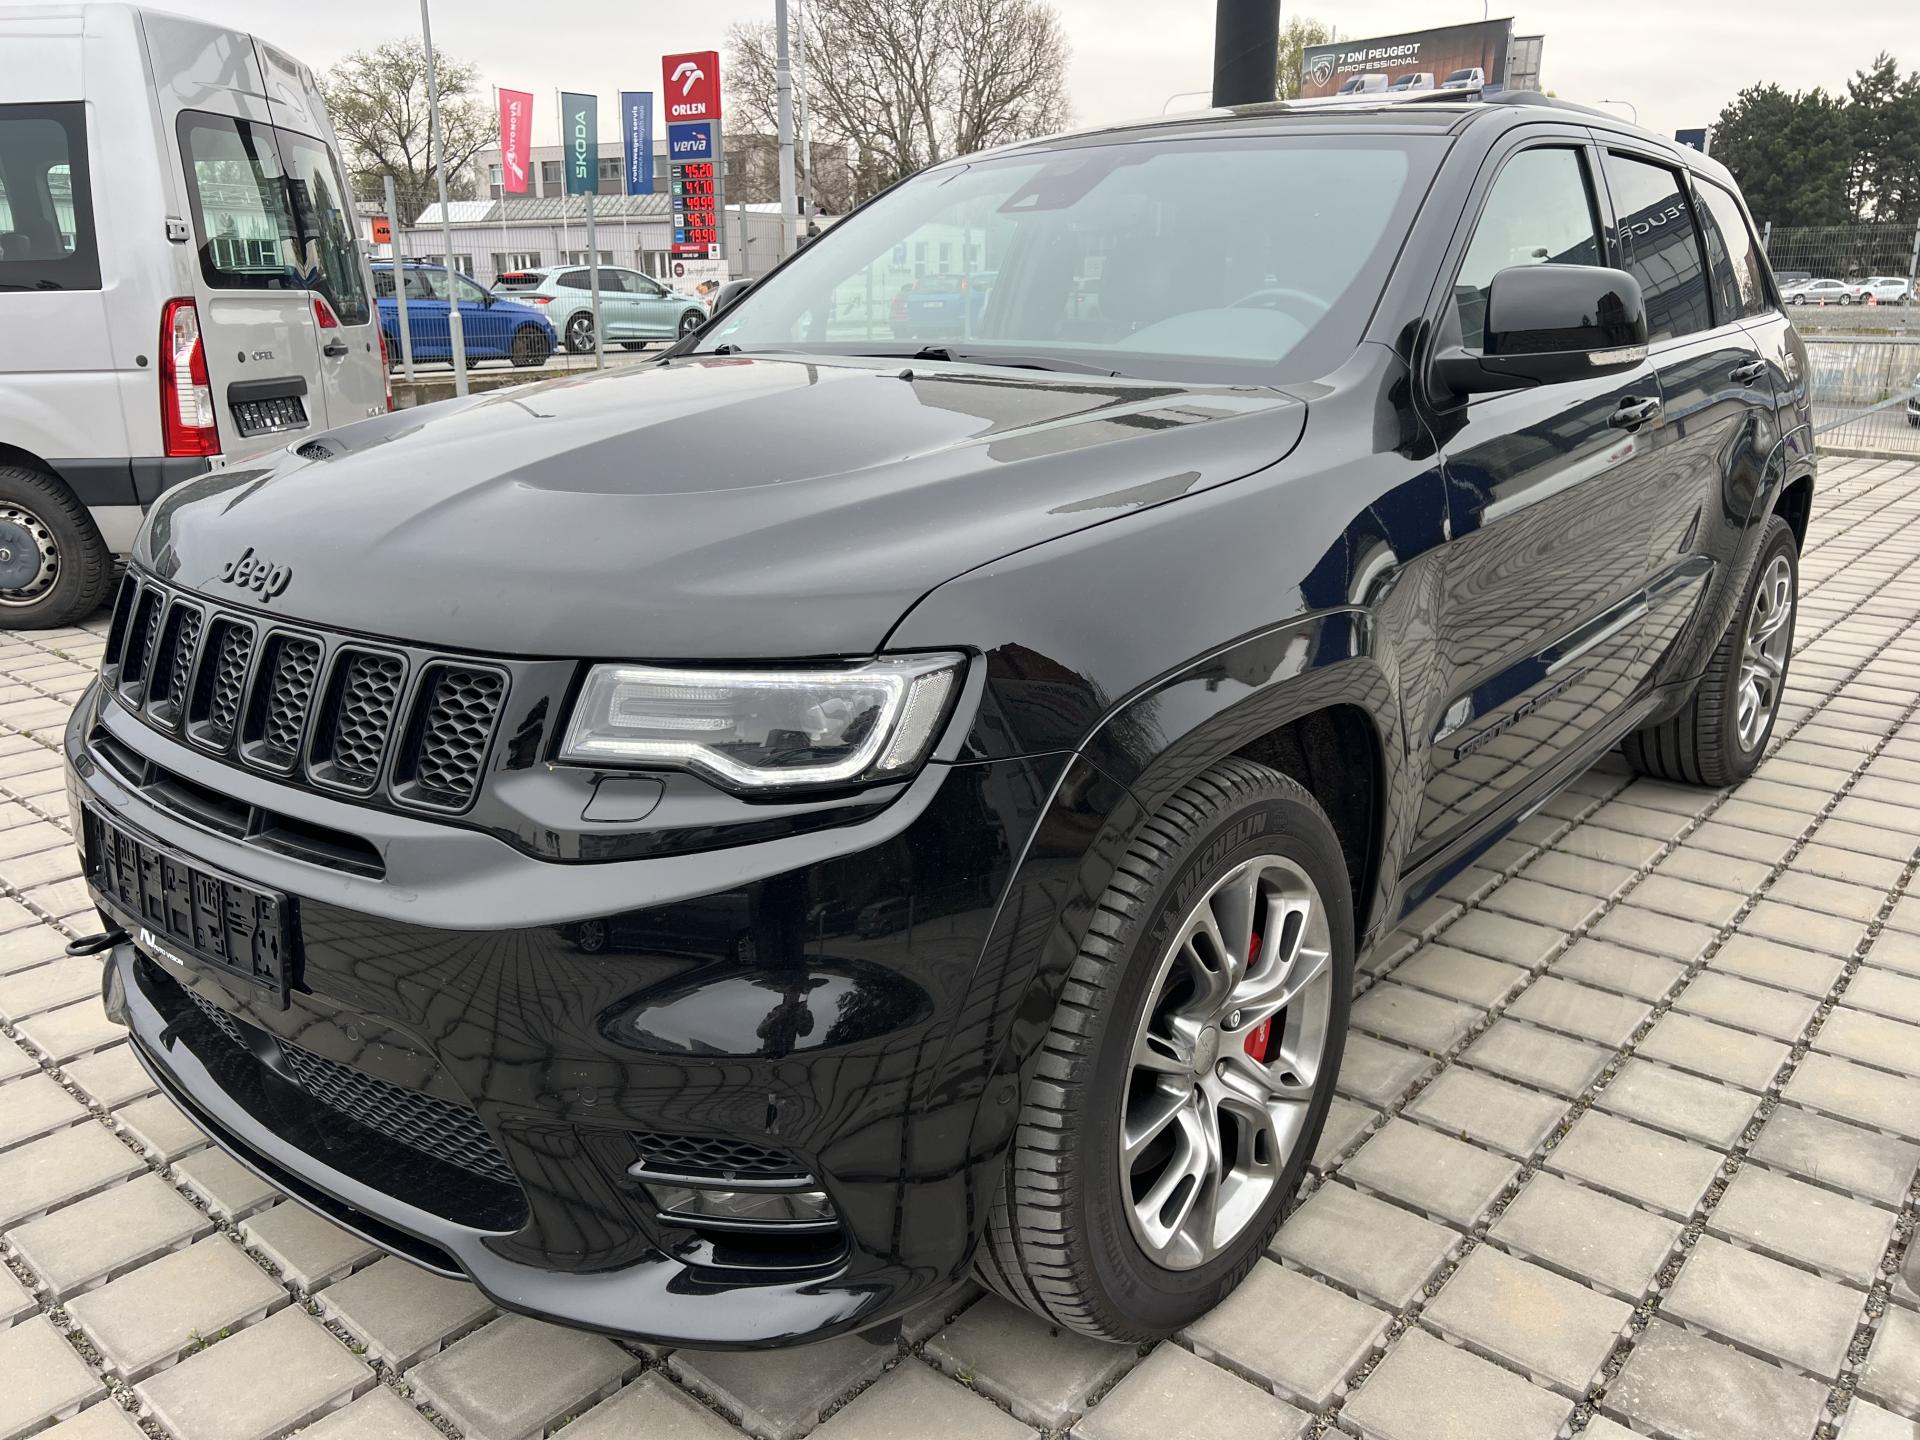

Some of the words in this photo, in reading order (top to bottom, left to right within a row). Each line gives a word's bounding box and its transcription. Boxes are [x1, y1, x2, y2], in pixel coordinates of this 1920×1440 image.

[1338, 53, 1346, 64] 7
[1347, 48, 1367, 63] DNÍ
[1368, 43, 1421, 60] PEUGEOT
[1337, 56, 1419, 74] PROFESSIONAL
[671, 102, 706, 116] ORLEN
[673, 139, 707, 152] verva
[685, 163, 713, 179] 45.20
[686, 180, 714, 195] 41.70
[686, 196, 715, 211] 49.99
[687, 212, 716, 227] 46.70
[689, 229, 717, 243] 19.90
[220, 547, 293, 603] Jeep
[1176, 811, 1268, 909] MICHELIN
